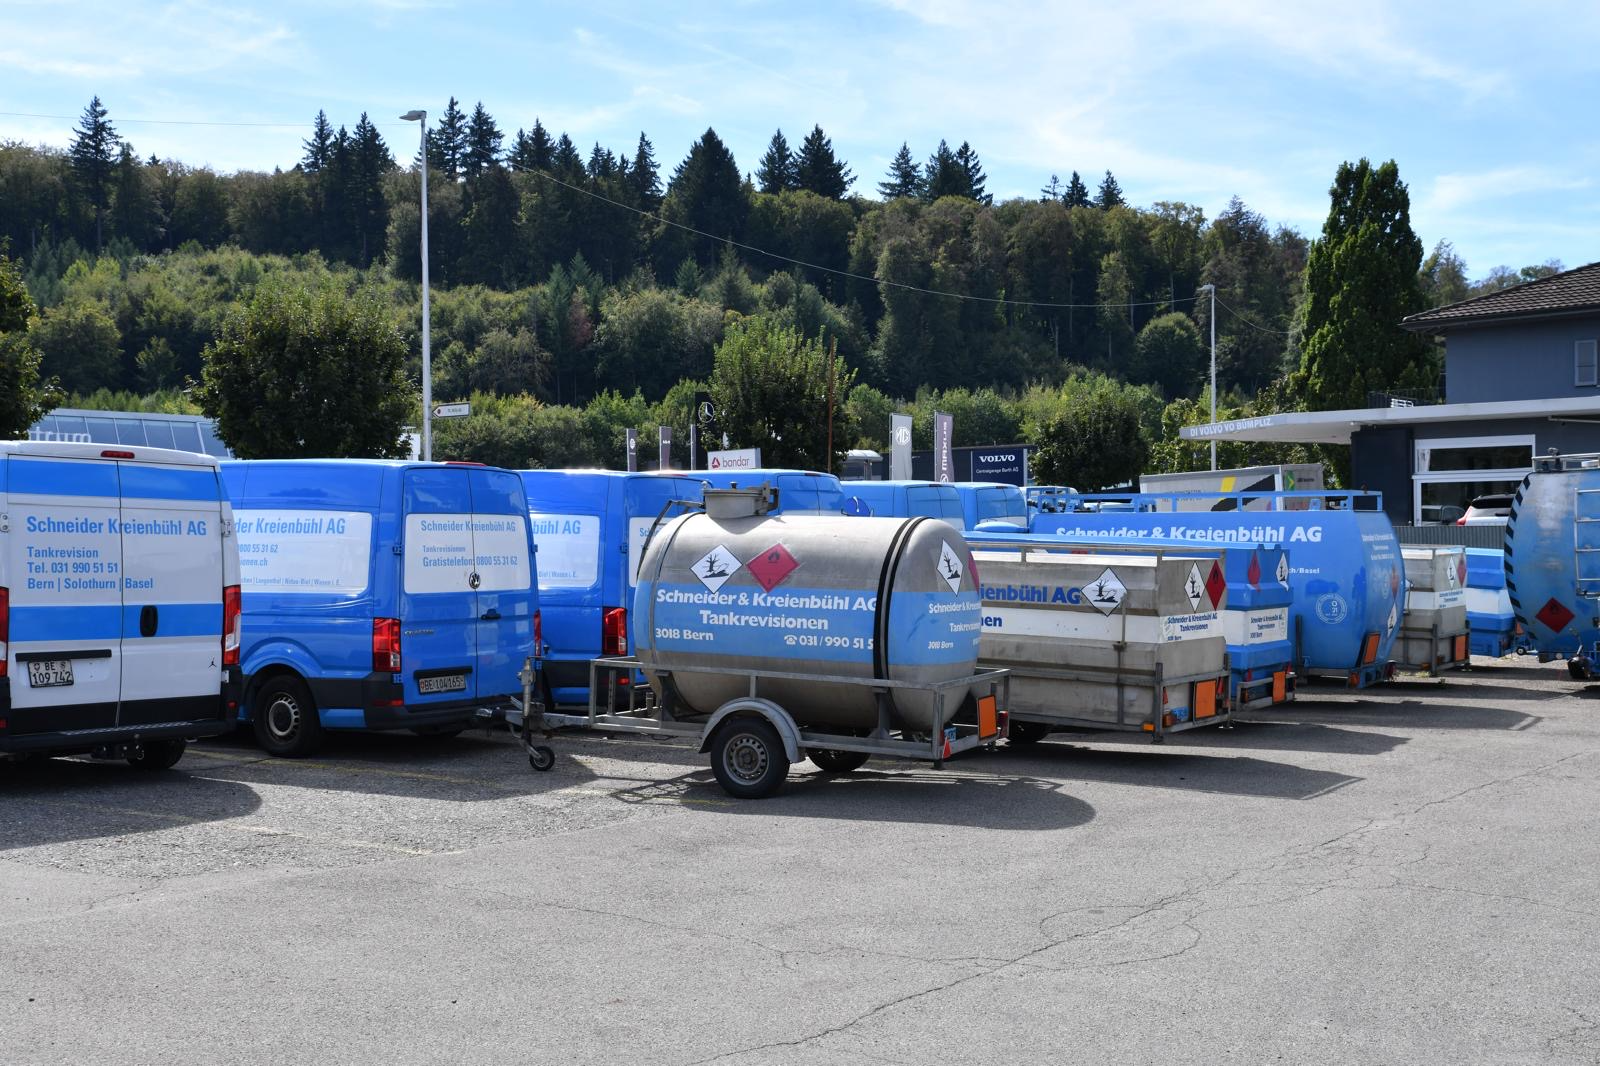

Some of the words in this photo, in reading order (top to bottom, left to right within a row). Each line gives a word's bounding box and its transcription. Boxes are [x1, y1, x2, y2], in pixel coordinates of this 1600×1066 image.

[722, 456, 750, 468] bandar
[979, 454, 1016, 463] VOLVO
[27, 516, 104, 534] Schneider
[108, 518, 182, 535] Kreienbühl
[187, 520, 207, 536] AG
[256, 518, 322, 534] Kreienbühl
[326, 518, 346, 534] AG
[421, 520, 464, 532] Schneider
[506, 521, 516, 532] AG
[562, 520, 582, 534] AG
[1056, 527, 1148, 538] Schneider
[1151, 526, 1165, 538] &
[1170, 526, 1285, 542] Kreienbühl
[1290, 526, 1322, 542] AG
[27, 546, 99, 558] Tankrevision
[27, 562, 49, 574] Tel.
[51, 562, 68, 574] 031
[72, 562, 90, 574] 990
[93, 562, 104, 574] 51
[107, 562, 118, 574] 51
[27, 578, 54, 590] Bern
[64, 577, 116, 590] Solothurn
[125, 577, 153, 589] Basel
[656, 589, 736, 606] Schneider
[737, 592, 750, 606] &
[753, 591, 848, 610] Kreienbühl
[980, 584, 1048, 603] ienbühl
[1052, 588, 1081, 605] AG
[699, 610, 829, 630] Tankrevisionen
[655, 628, 680, 639] 3018
[683, 629, 714, 641] Bern
[853, 637, 865, 649] 51
[867, 638, 874, 650] 5
[44, 661, 55, 671] BE
[33, 672, 51, 684] 109
[52, 670, 71, 683] 742
